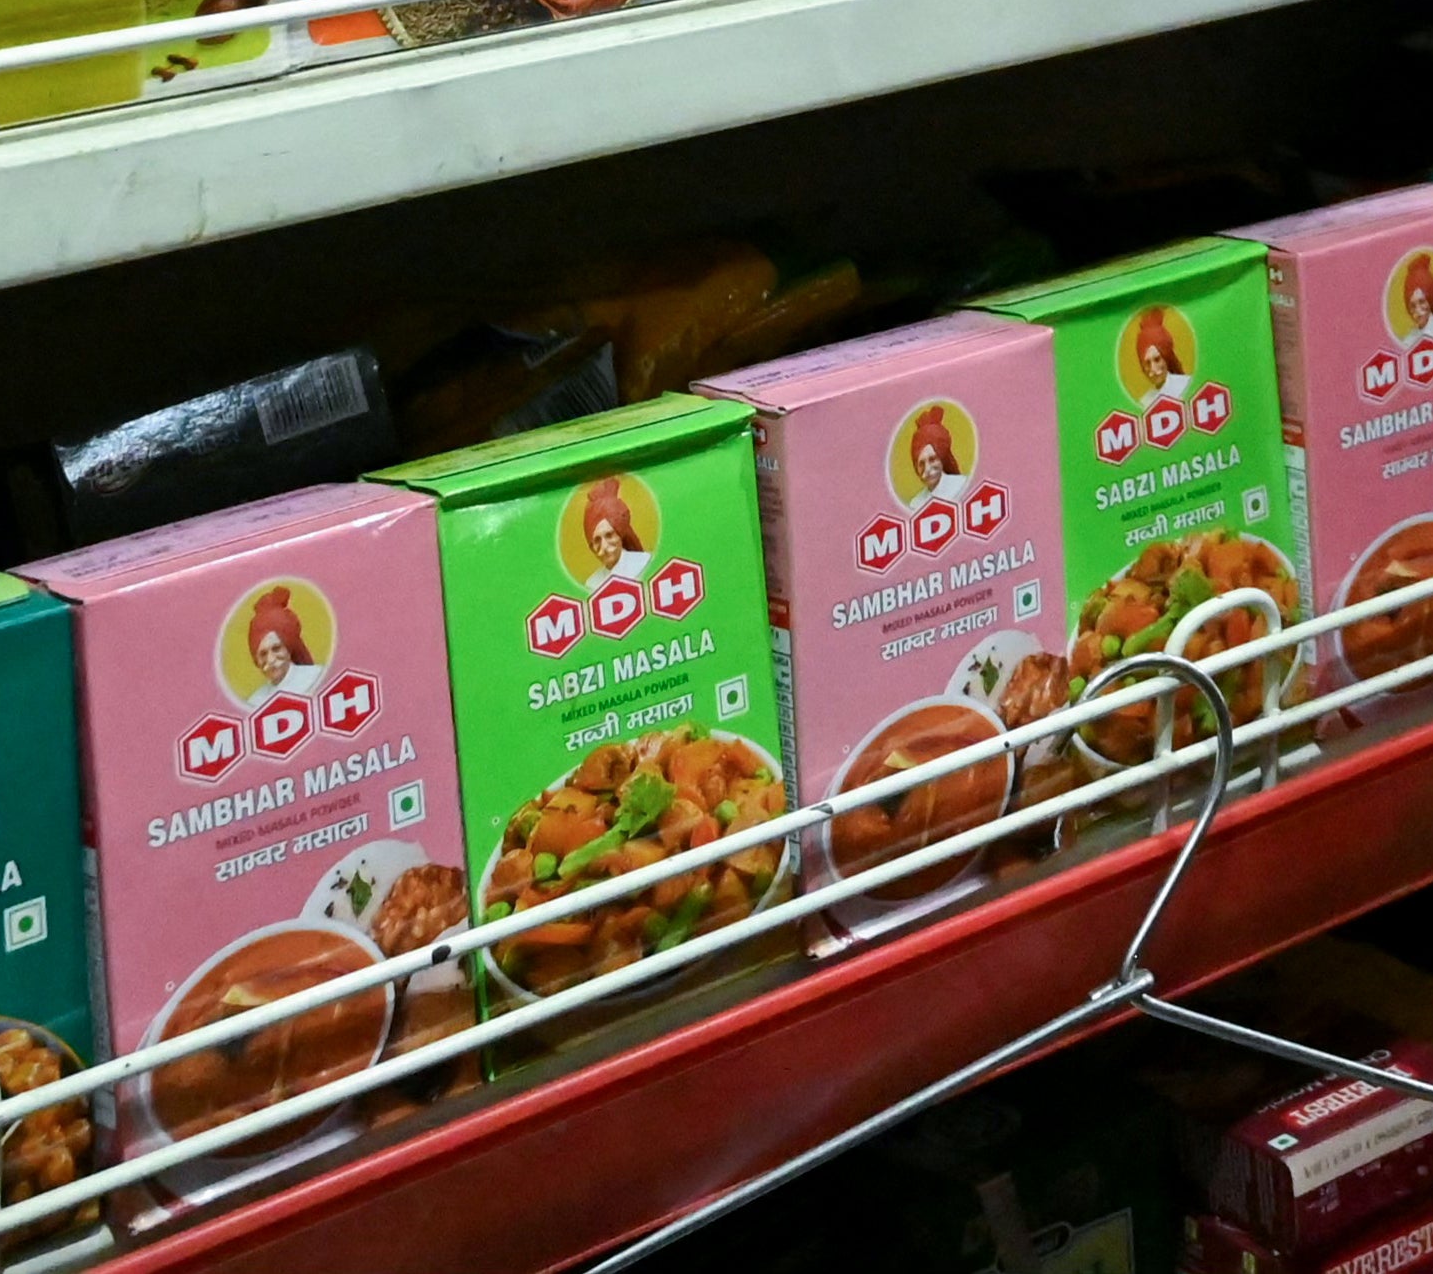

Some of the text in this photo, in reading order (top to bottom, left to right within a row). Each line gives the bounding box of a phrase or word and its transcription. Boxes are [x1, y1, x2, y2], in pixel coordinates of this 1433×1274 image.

[1095, 444, 1242, 511] SABZI MASALA
[831, 538, 1037, 630] SAMBHAR MASALA
[527, 628, 716, 712] SABZI MASALA
[625, 691, 695, 732] मसाला
[146, 735, 417, 849] SAMBHAR MASALA
